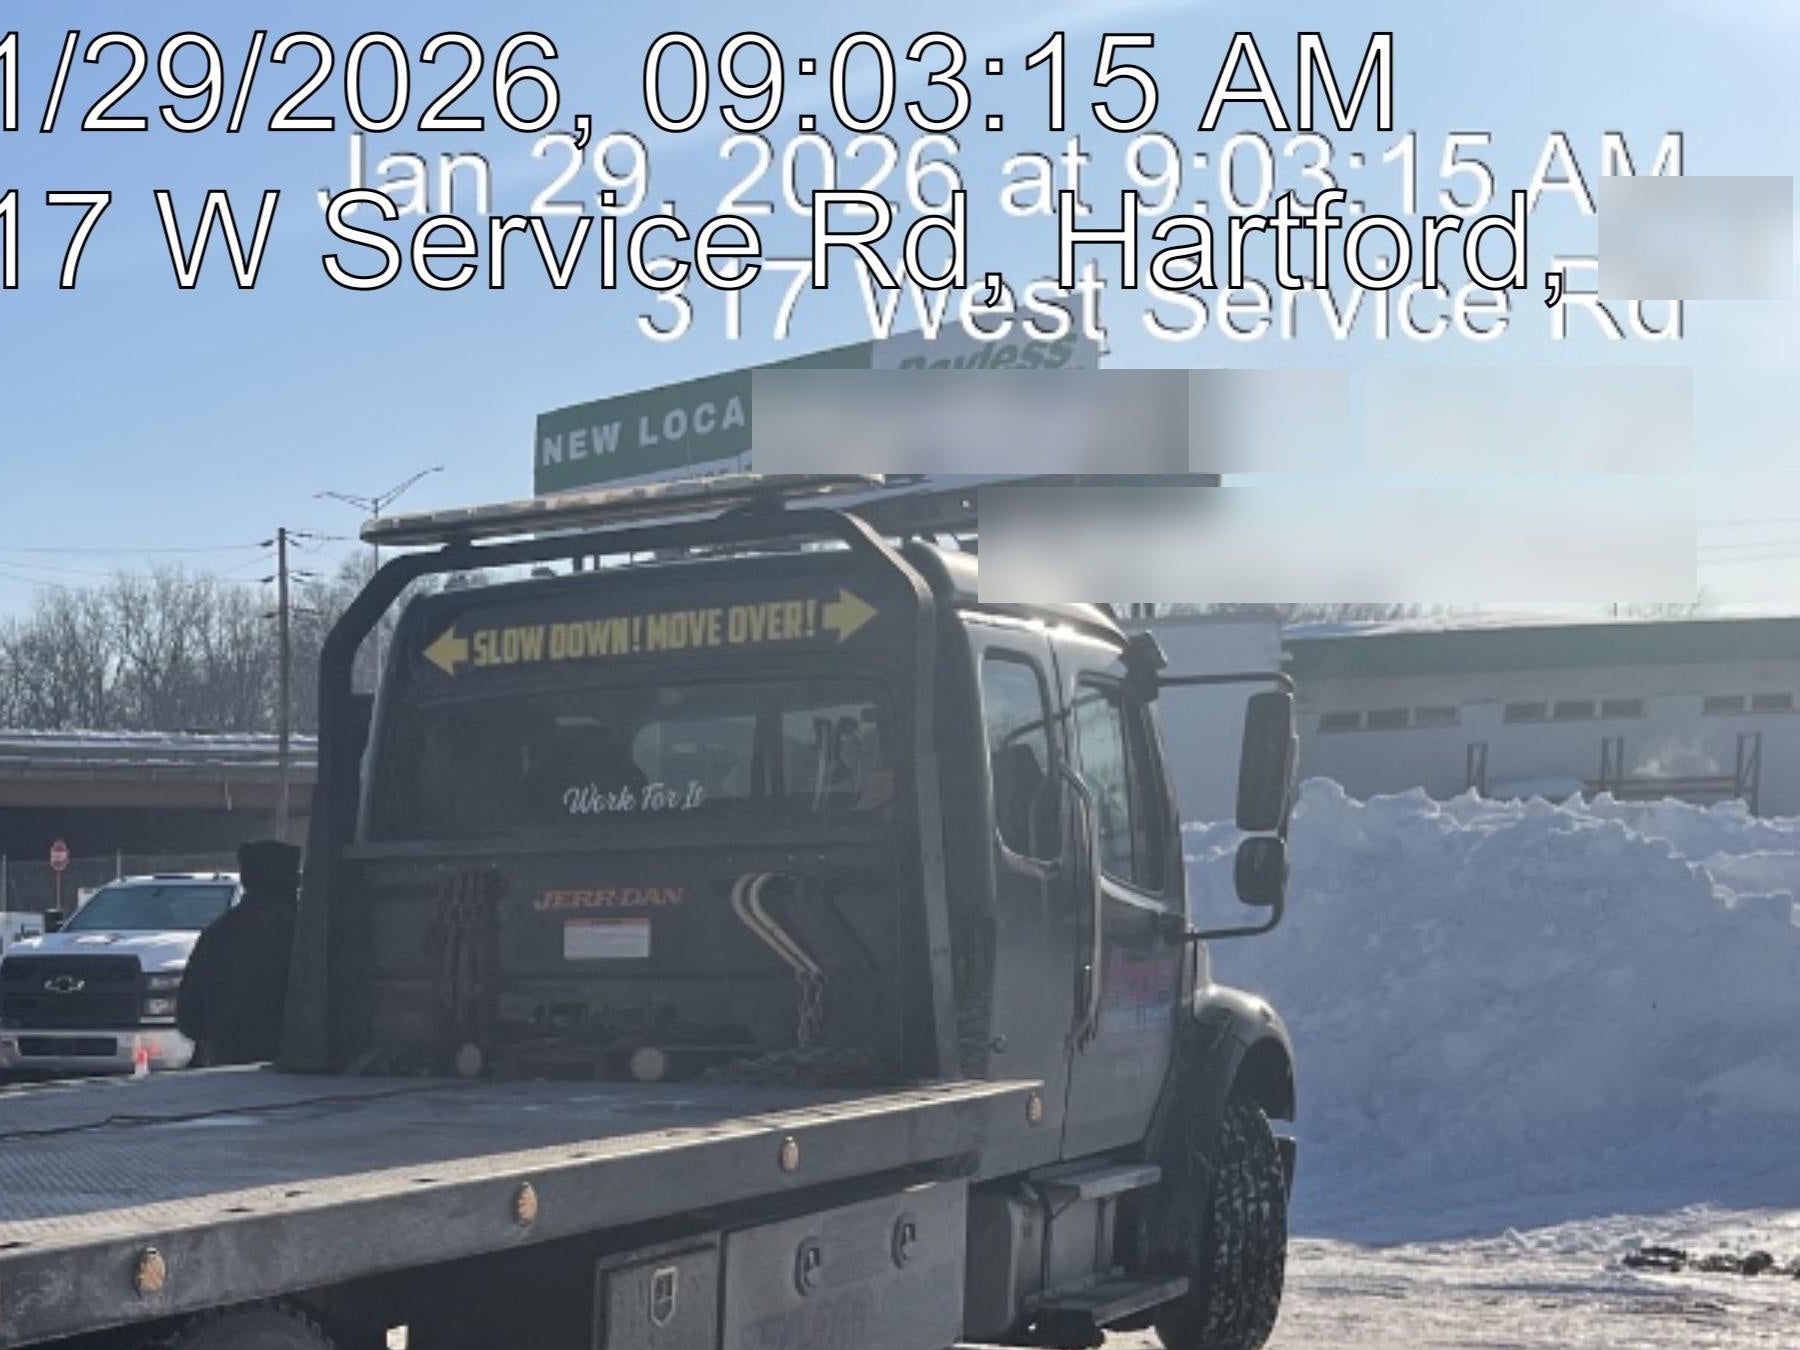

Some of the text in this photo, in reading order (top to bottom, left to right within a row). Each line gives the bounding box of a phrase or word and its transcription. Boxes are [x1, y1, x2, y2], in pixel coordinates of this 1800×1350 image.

[542, 422, 622, 465] NEW
[473, 600, 816, 665] SLOW DOWN! MOVE OVER!
[563, 782, 635, 814] Work
[641, 782, 679, 811] For
